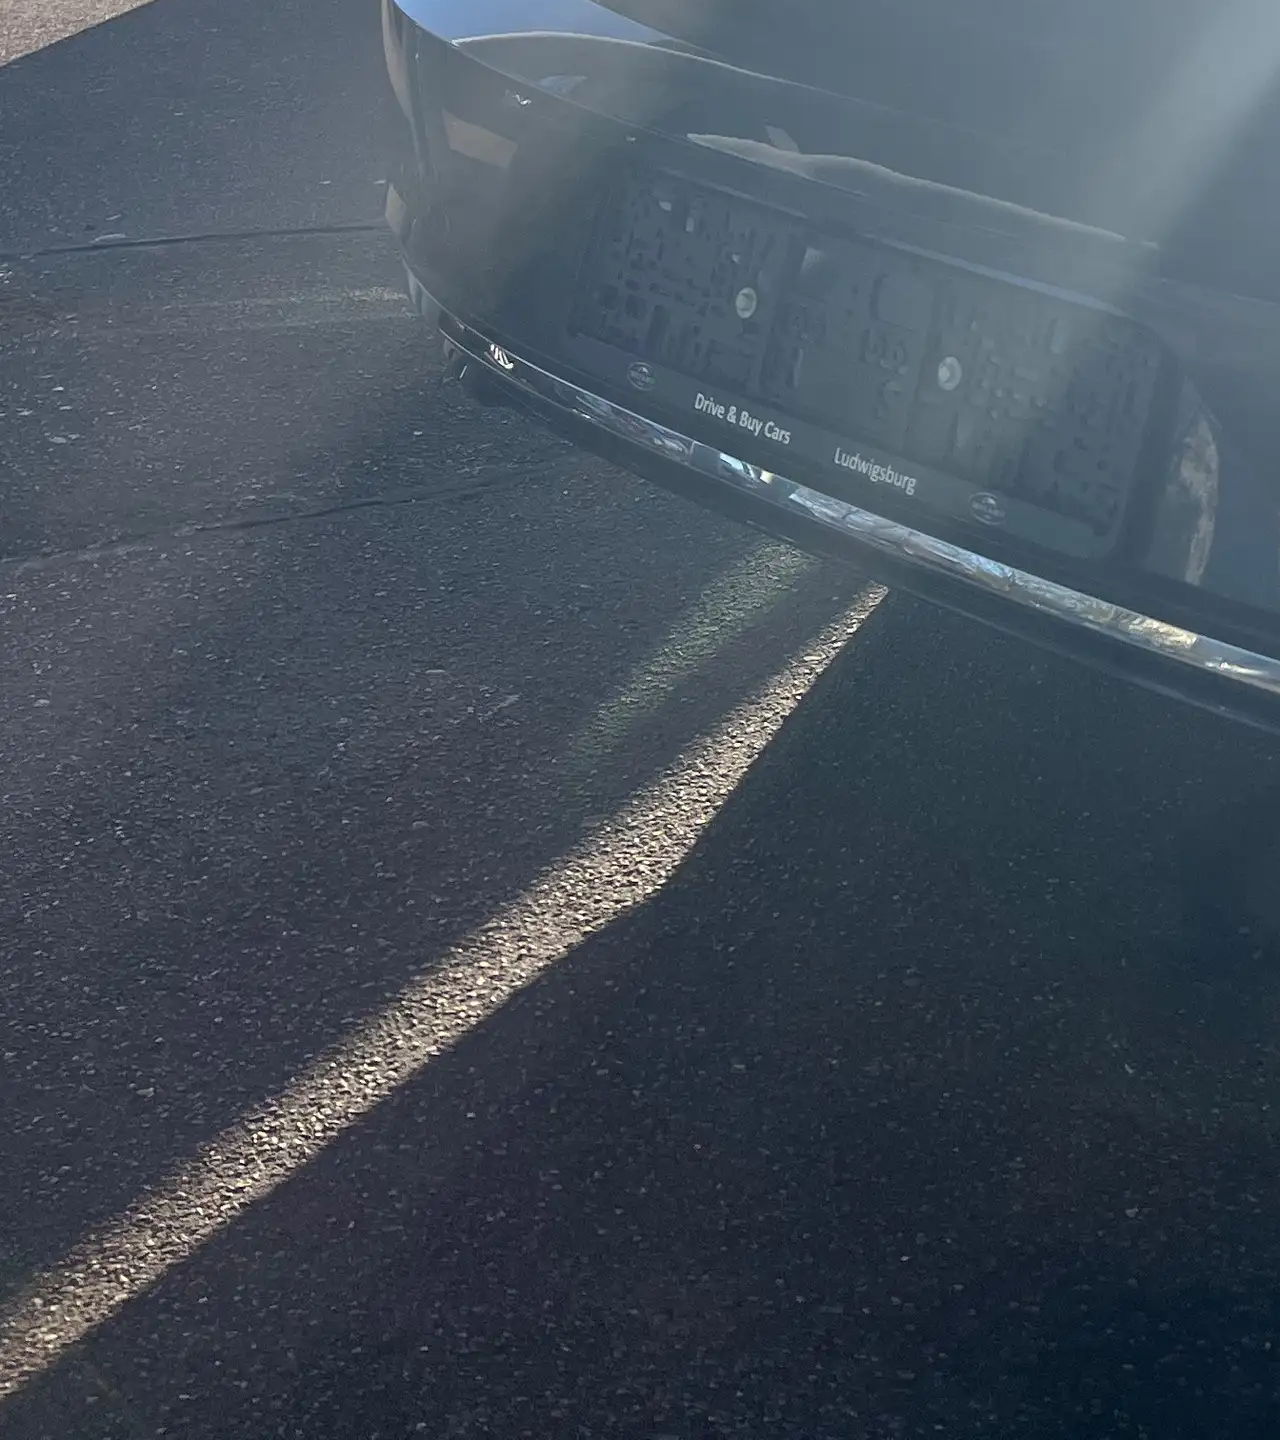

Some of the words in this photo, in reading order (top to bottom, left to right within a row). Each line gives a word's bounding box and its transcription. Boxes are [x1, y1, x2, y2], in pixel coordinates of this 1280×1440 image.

[694, 392, 726, 420] Drive
[726, 405, 738, 424] &
[739, 410, 763, 437] Buy
[763, 420, 792, 445] Cars
[833, 446, 917, 496] Ludwigsburg
